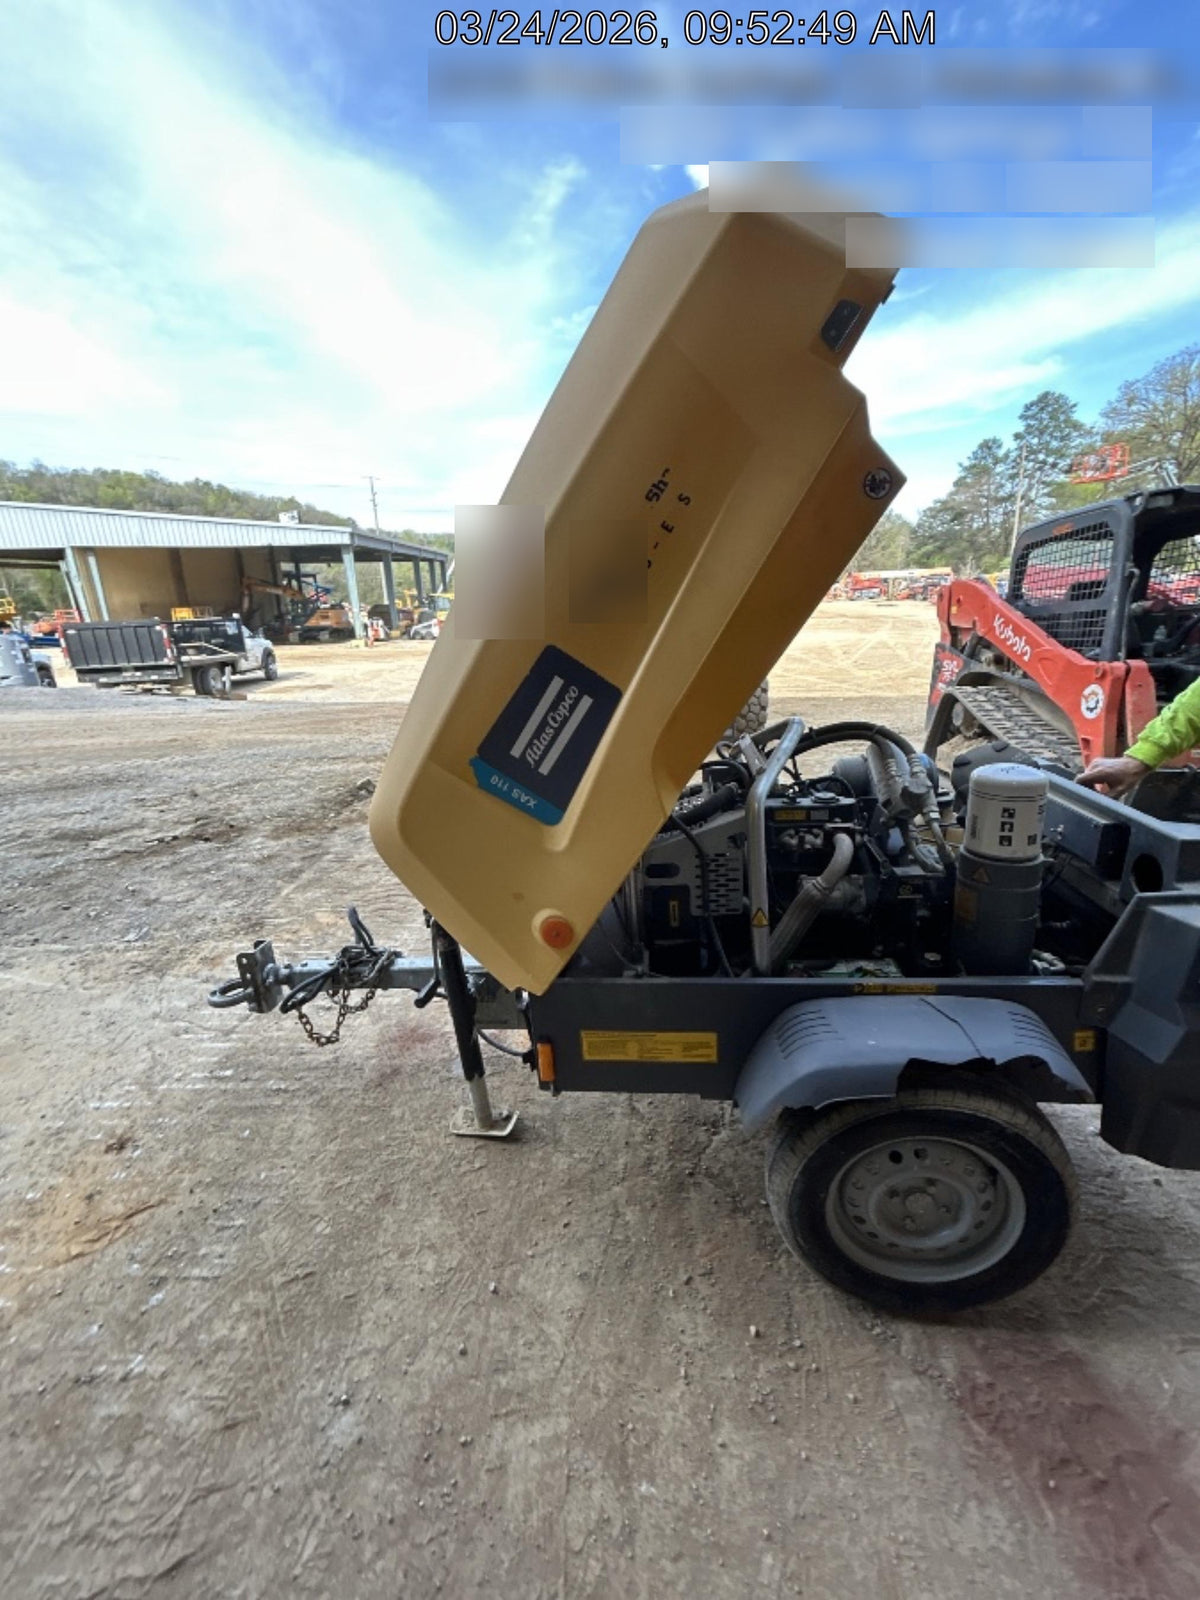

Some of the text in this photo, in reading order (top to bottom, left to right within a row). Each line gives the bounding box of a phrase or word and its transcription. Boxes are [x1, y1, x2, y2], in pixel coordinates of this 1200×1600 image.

[993, 613, 1031, 662] Kubota
[525, 685, 579, 769] Atlas Copco
[490, 775, 538, 809] XAS 110
